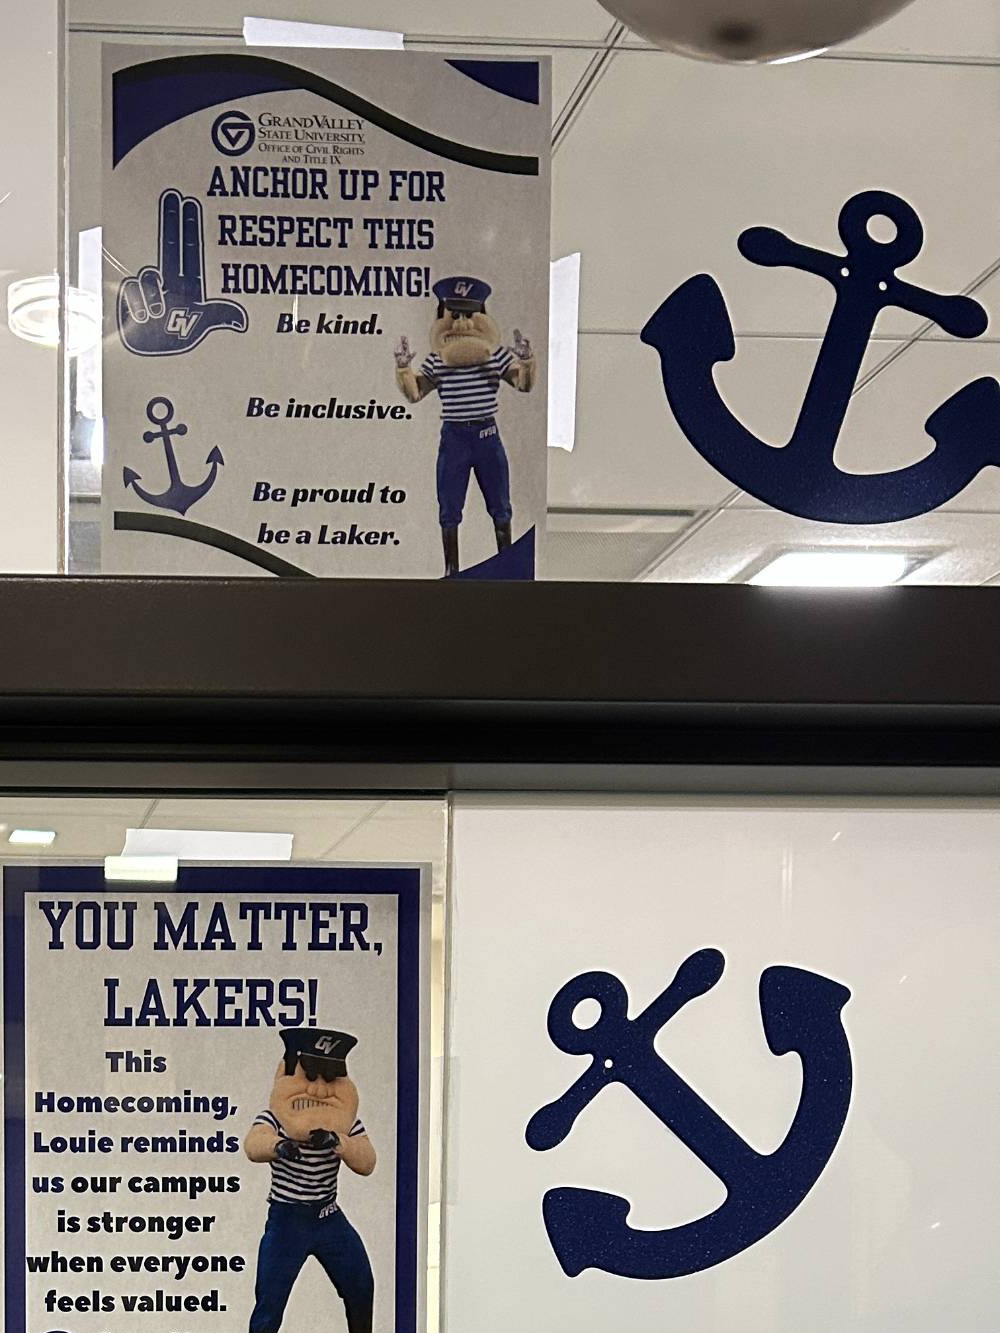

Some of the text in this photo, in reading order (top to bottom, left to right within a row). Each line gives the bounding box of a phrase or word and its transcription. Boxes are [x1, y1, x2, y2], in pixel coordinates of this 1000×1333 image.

[258, 128, 292, 140] STATE
[258, 142, 365, 155] OFFICE OF CIVIL RIGHTS
[282, 155, 342, 165] AND TITLE IX
[207, 166, 446, 202] ANCHOR UP FOR
[218, 215, 434, 250] RESPECT THIS
[221, 264, 431, 298] HOMECOMING!
[164, 307, 203, 340] GV
[276, 313, 383, 335] Be kind.
[247, 398, 412, 421] Be inclusive.
[253, 482, 406, 507] Be proud to
[257, 524, 400, 546] be a Laker.
[38, 901, 383, 956] YOU MATTER,
[104, 978, 318, 1027] LAKERS!
[105, 1050, 167, 1073] This
[34, 1090, 238, 1120] Homecoming,
[33, 1131, 239, 1153] Louie reminds
[33, 1176, 240, 1199] us our campus
[57, 1210, 216, 1240] is stronger
[26, 1250, 246, 1280] when everyone
[44, 1290, 227, 1313] feels valued.
